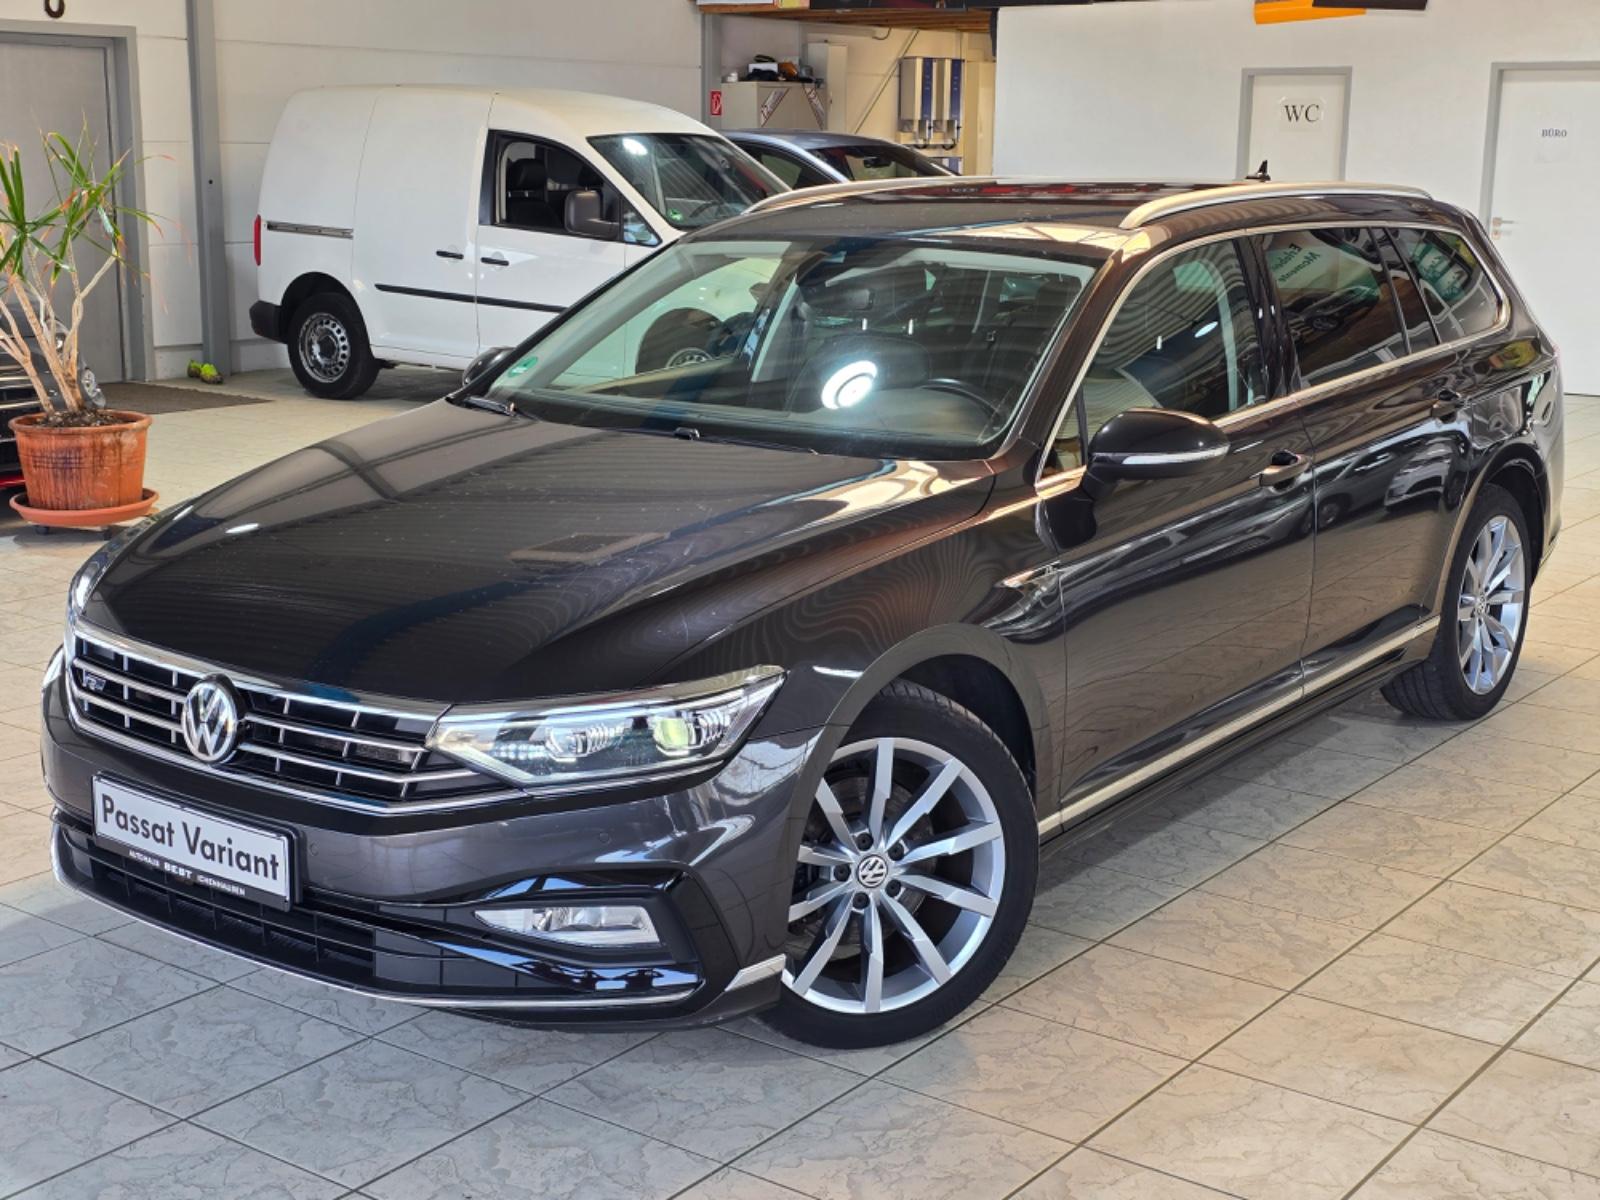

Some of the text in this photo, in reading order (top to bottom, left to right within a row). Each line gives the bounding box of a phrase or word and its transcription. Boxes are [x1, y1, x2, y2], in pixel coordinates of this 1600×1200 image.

[1284, 103, 1320, 122] WC
[1541, 127, 1568, 137] BÜRO
[102, 793, 279, 881] Passat Variant
